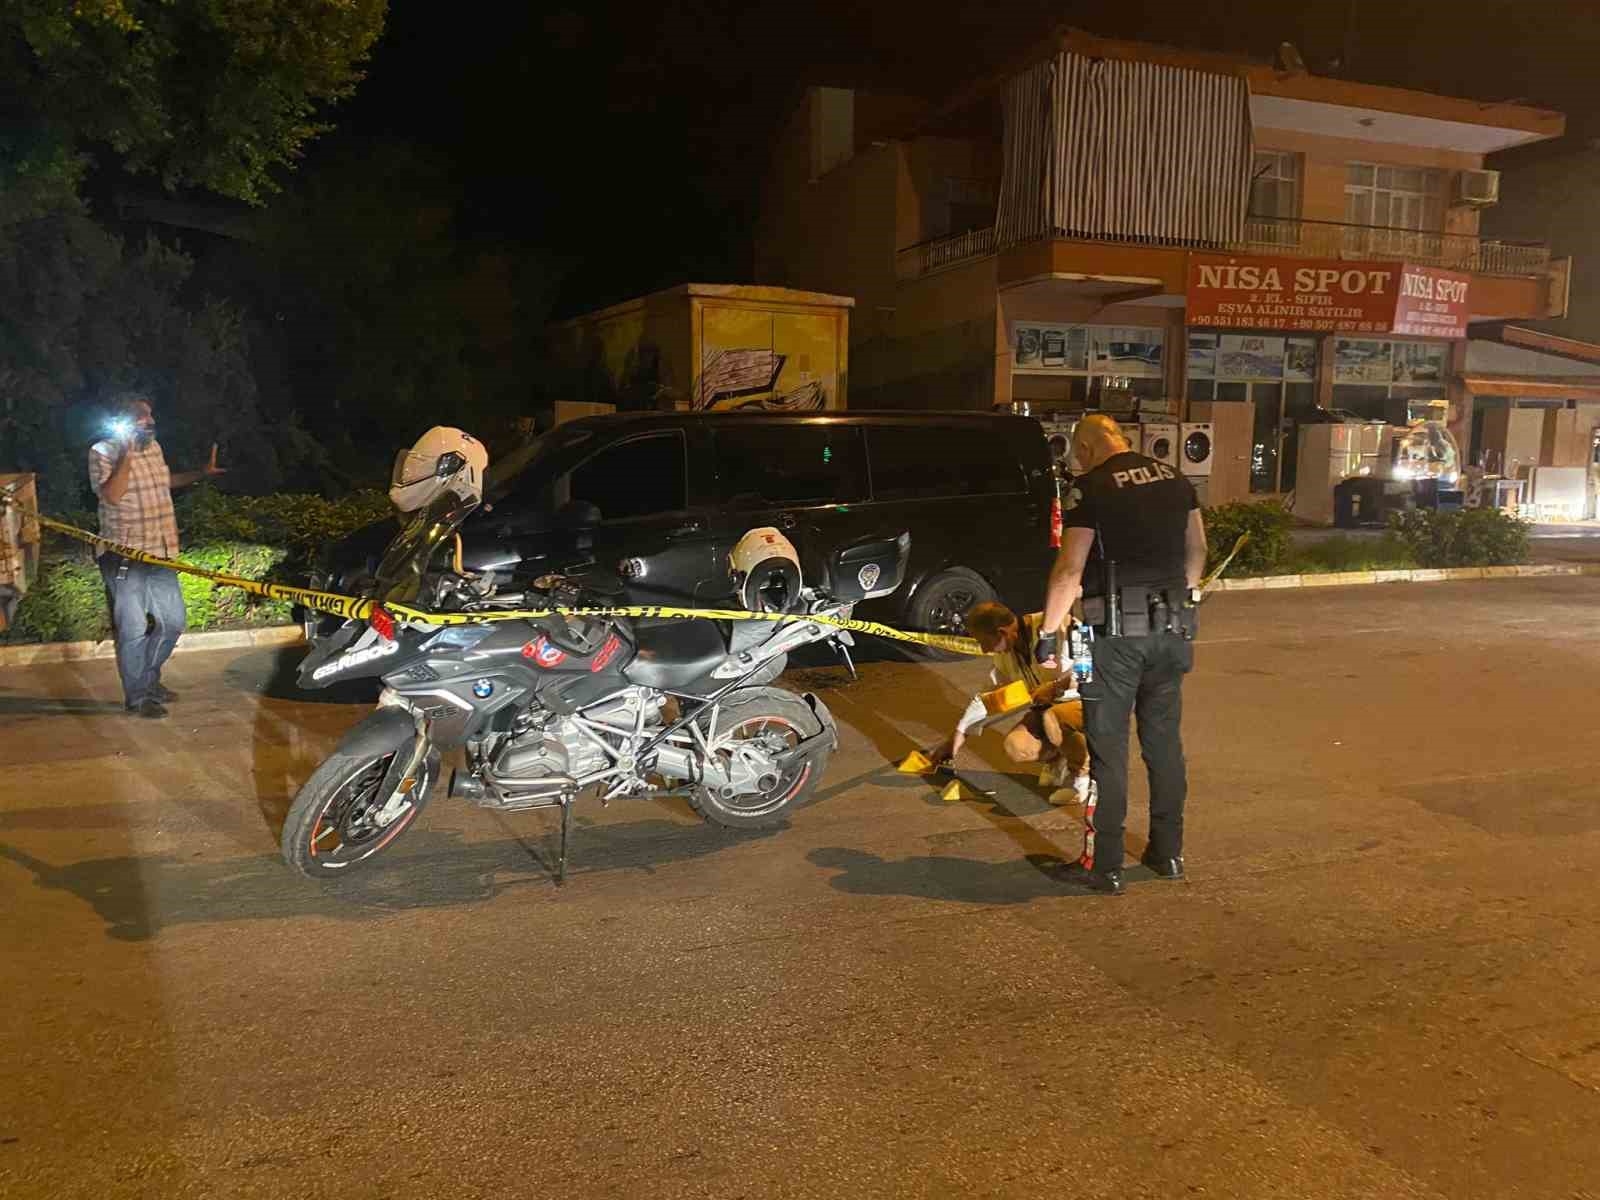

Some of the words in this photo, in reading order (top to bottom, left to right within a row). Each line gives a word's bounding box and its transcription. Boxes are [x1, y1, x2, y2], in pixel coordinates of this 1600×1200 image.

[1196, 259, 1284, 291] NİSA
[1294, 268, 1391, 294] SPOT
[1400, 267, 1433, 299] NİSA
[1435, 278, 1468, 303] SPOT
